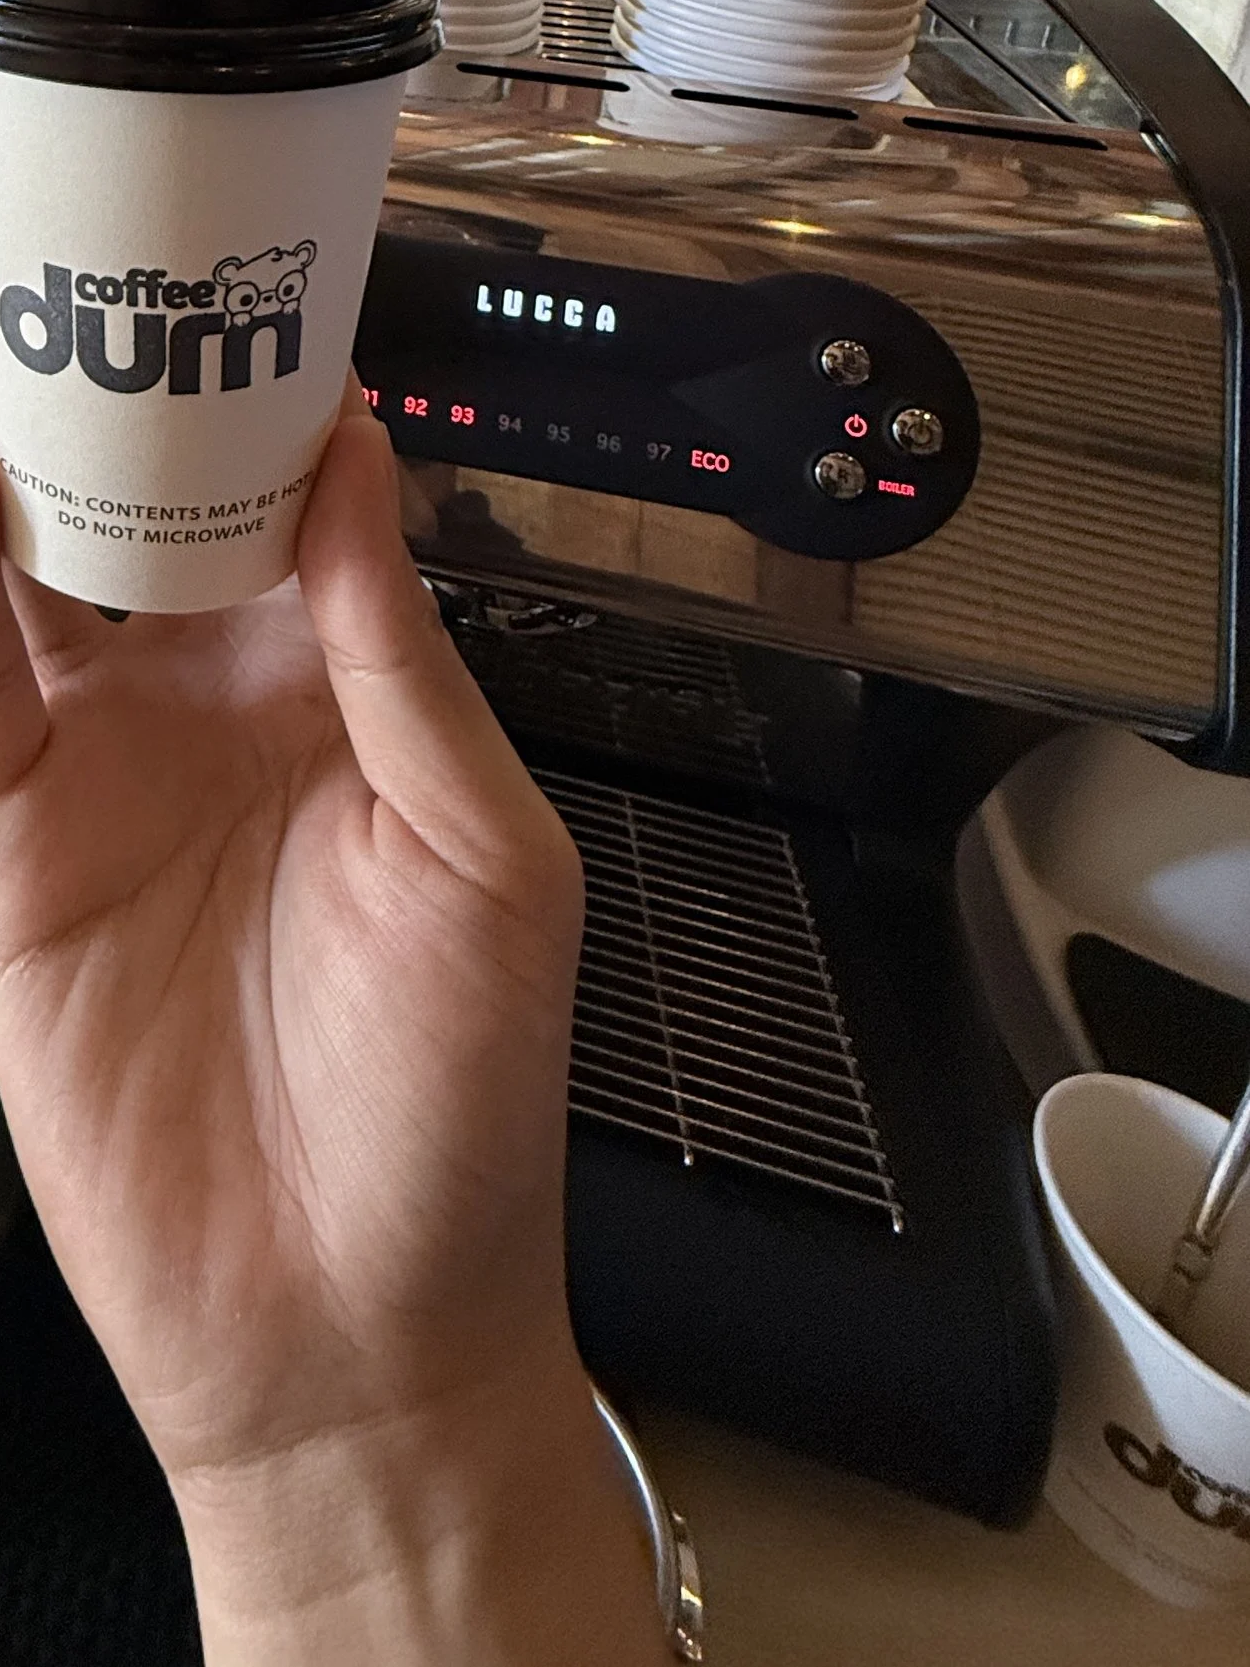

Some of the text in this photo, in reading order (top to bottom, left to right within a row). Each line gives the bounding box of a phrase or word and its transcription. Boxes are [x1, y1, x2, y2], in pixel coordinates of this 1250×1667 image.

[75, 268, 216, 310] coffee
[476, 284, 617, 333] LUCCA
[404, 396, 428, 416] 92
[451, 405, 475, 425] 93
[498, 414, 522, 433] 94
[547, 424, 570, 443] 95
[596, 433, 622, 453] 96
[646, 443, 671, 462] 97
[691, 450, 730, 472] ECO
[0, 457, 80, 507] CAUTION:
[85, 497, 201, 521] CONTENTS
[207, 498, 251, 519] MAY
[255, 490, 277, 509] BE
[878, 480, 915, 497] BOILER
[58, 510, 265, 545] DO NOT MICROWAVE
